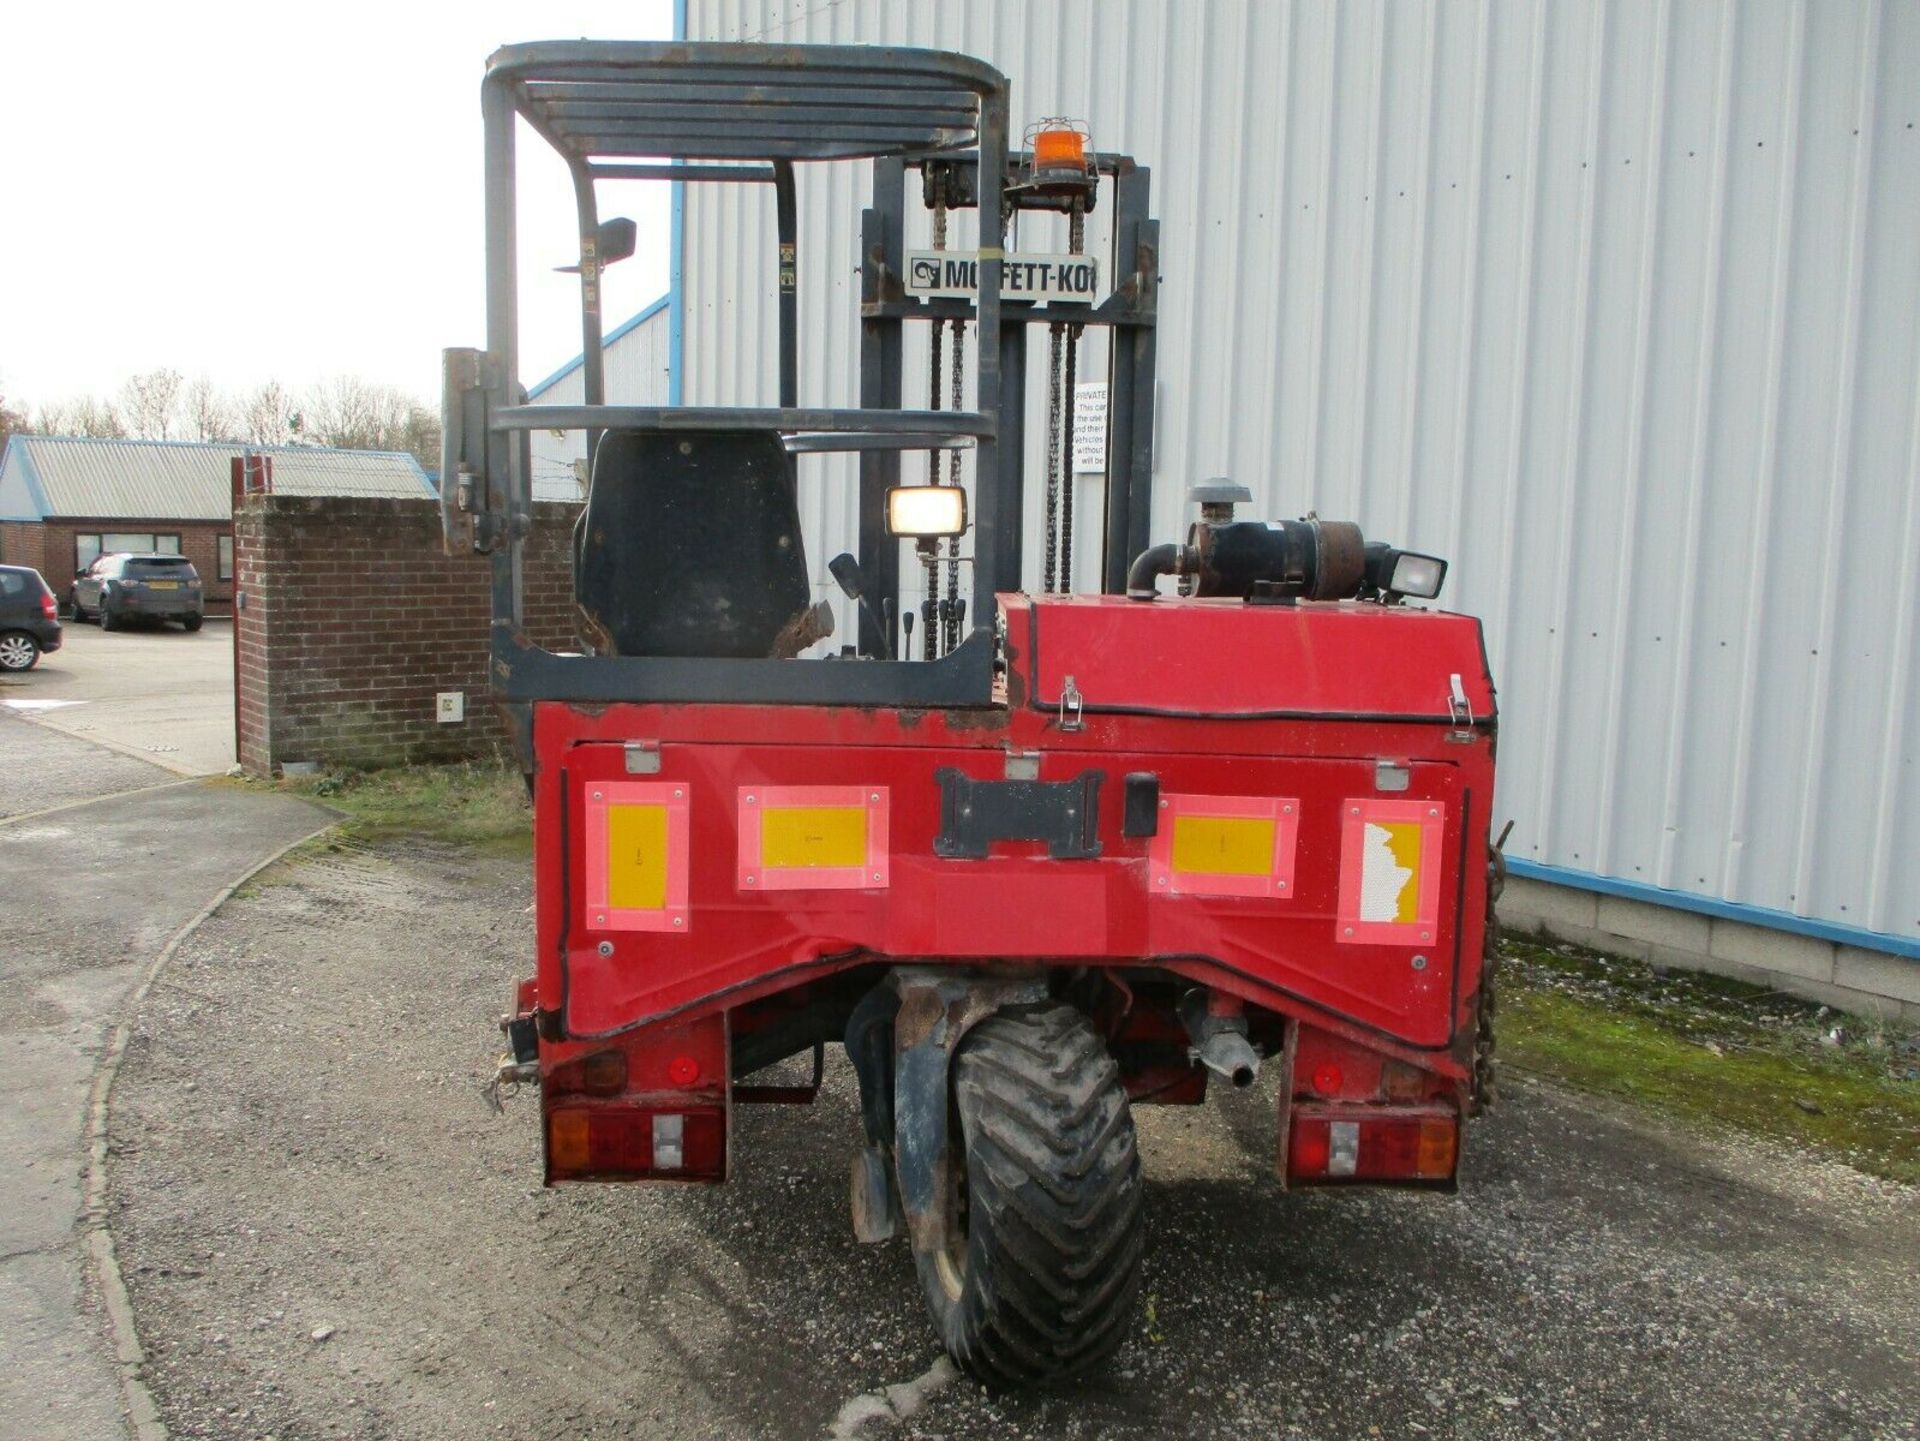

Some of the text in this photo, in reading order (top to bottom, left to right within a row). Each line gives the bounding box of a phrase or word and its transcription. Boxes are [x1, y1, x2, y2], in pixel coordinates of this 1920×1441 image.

[1076, 391, 1107, 400] PRIVATE
[1080, 404, 1094, 412] This
[1088, 425, 1103, 433] their
[1077, 447, 1103, 455] without
[1082, 457, 1103, 465] will be
